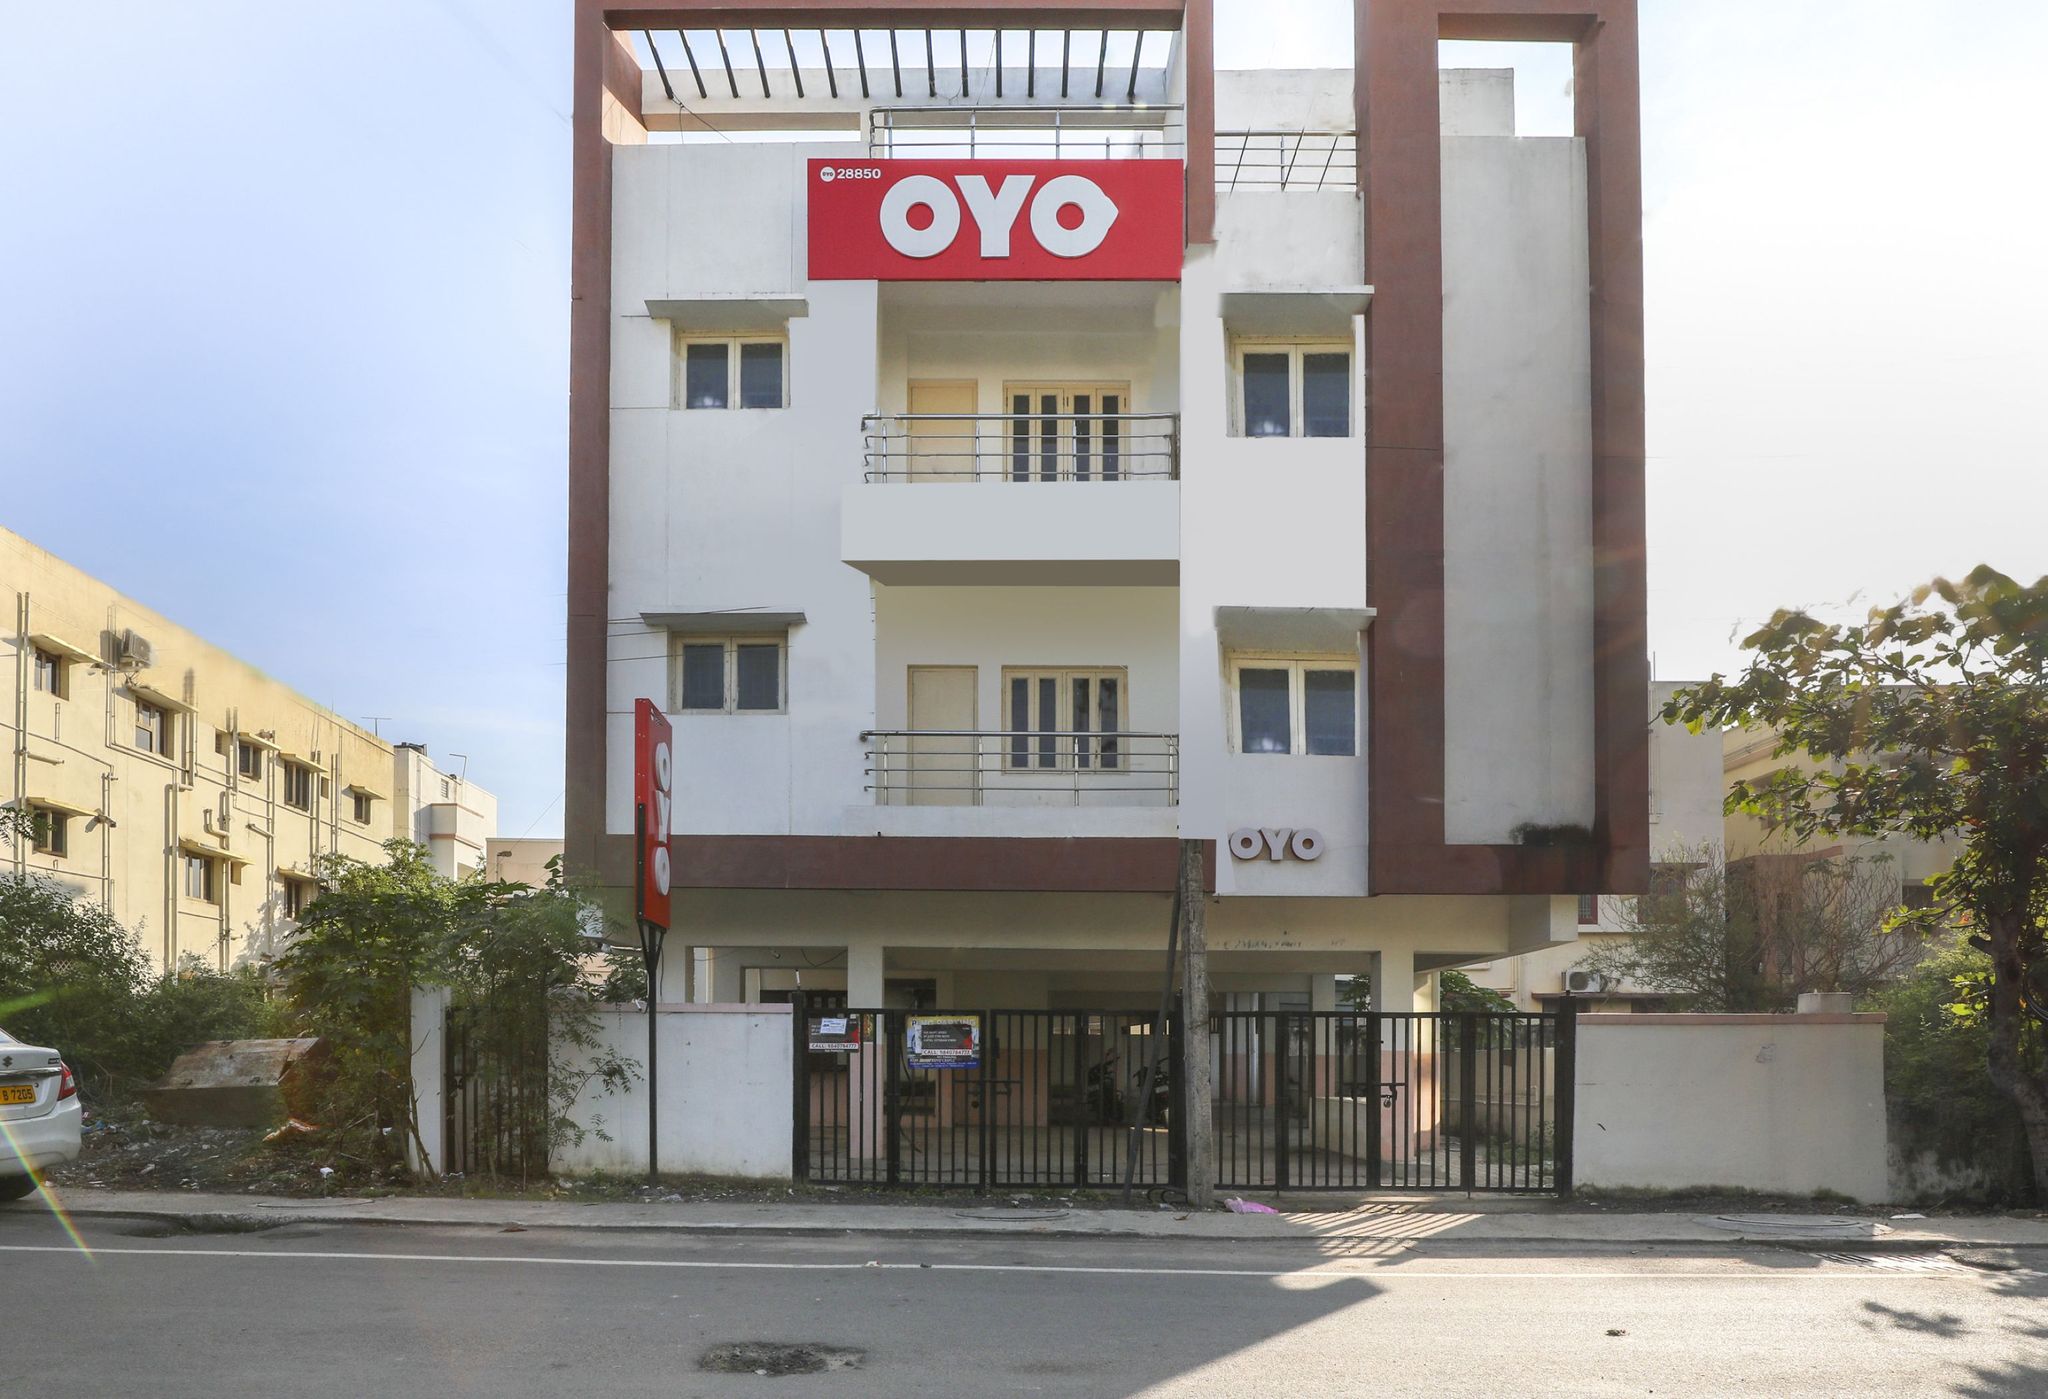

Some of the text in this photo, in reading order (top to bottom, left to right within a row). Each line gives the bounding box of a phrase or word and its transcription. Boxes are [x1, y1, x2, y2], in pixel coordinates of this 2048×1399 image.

[837, 168, 881, 179] 28850
[879, 174, 1119, 259] OYO
[654, 741, 671, 896] OYO
[1229, 827, 1325, 861] OYO
[2, 1088, 33, 1101] B 7205
